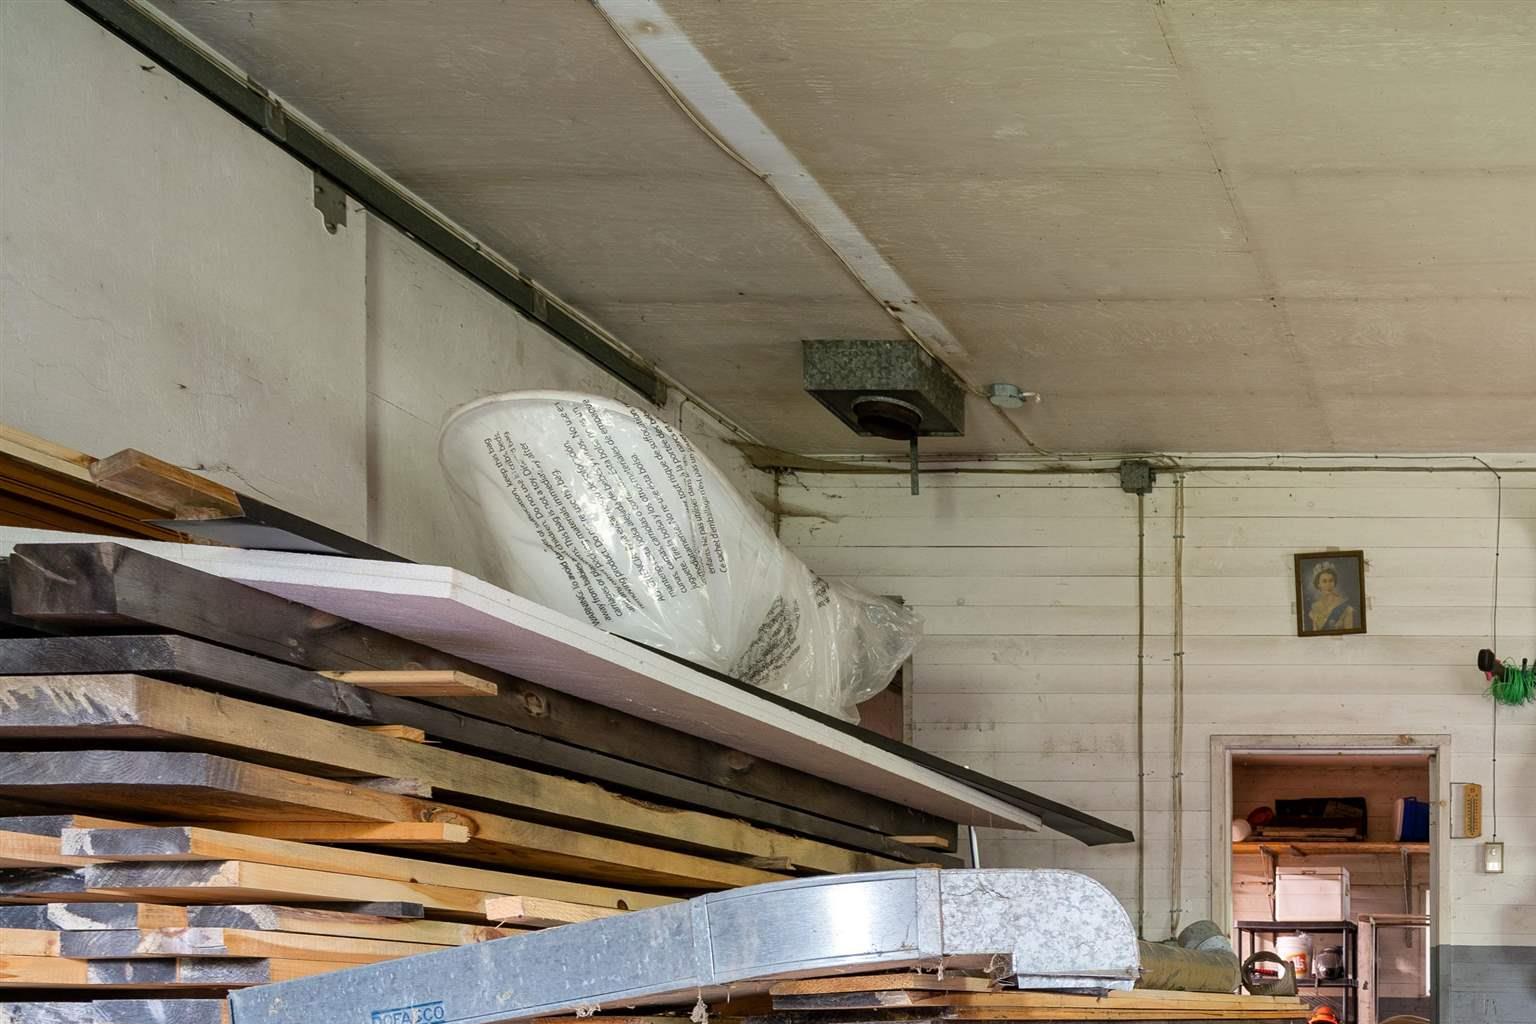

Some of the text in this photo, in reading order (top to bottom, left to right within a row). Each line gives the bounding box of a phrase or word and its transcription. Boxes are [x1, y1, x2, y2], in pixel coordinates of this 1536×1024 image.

[566, 425, 579, 439] No
[602, 434, 615, 447] de
[524, 491, 536, 507] not
[539, 495, 551, 510] not
[531, 505, 543, 519] Do
[546, 508, 555, 517] is
[643, 501, 655, 514] los
[652, 511, 661, 520] y
[550, 514, 566, 533] bag
[654, 518, 670, 540] bolsa
[559, 530, 574, 548] This
[590, 534, 603, 548] Do
[595, 576, 604, 587] or
[584, 585, 600, 604] from
